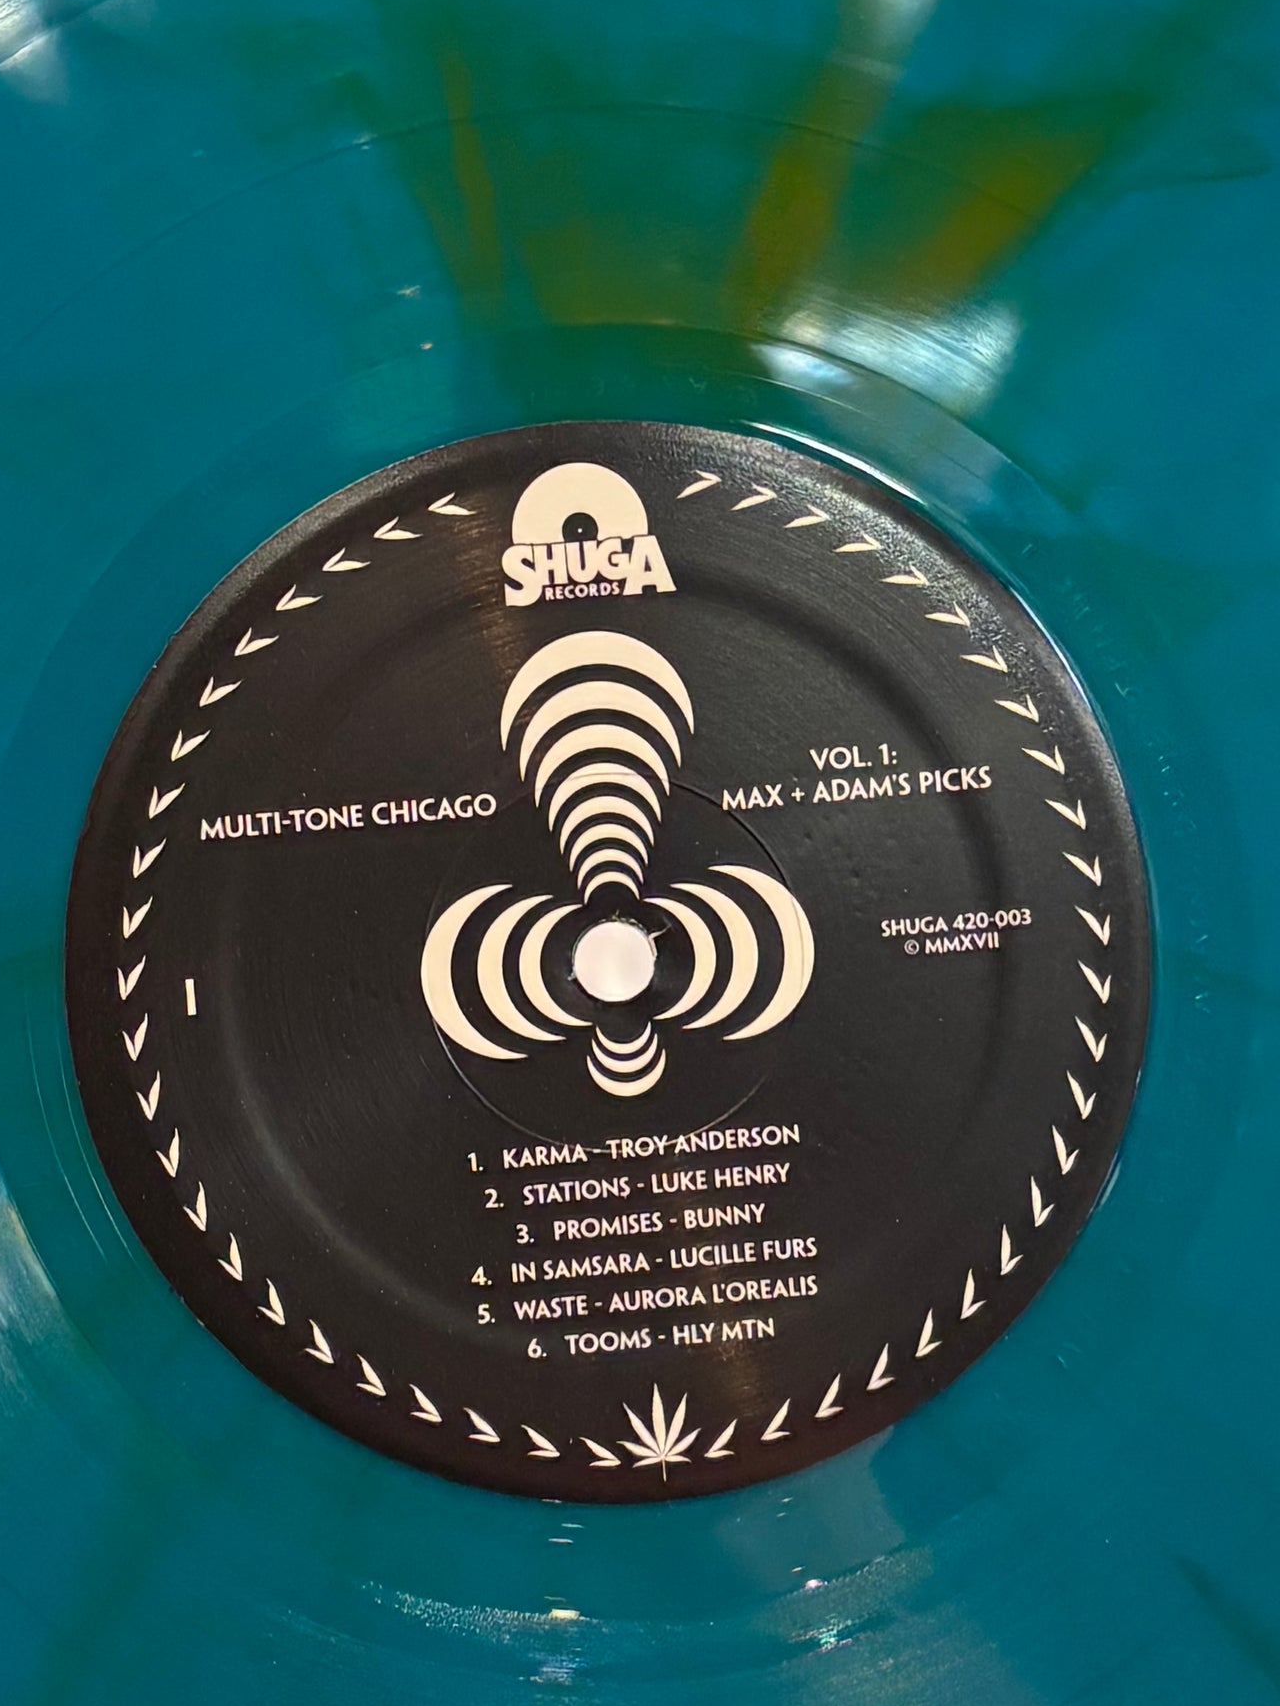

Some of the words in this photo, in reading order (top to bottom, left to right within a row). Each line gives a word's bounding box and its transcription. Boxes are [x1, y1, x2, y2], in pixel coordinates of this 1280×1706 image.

[502, 532, 676, 606] SHUGA
[542, 580, 619, 600] RECORDS
[810, 746, 872, 770] VOL.
[879, 743, 897, 765] 1:
[723, 784, 783, 810] MAX
[791, 787, 805, 801] +
[813, 773, 911, 803] ADAM'S
[919, 766, 992, 793] PICKS
[201, 805, 364, 840] MULTI-TONE
[372, 794, 496, 824] CHICAGO
[881, 916, 948, 936] SHUGA
[953, 909, 1031, 930] 420-003
[925, 932, 999, 953] MMXVII
[468, 1153, 483, 1171] 1.
[503, 1144, 587, 1168] KARMA
[606, 1136, 669, 1159] TROY
[674, 1124, 800, 1153] ANDERSON
[485, 1189, 504, 1208] 2.
[523, 1177, 630, 1205] STATIONS
[652, 1170, 707, 1193] LUKE
[715, 1163, 789, 1188] HENRY
[517, 1224, 534, 1243] 3.
[554, 1212, 663, 1240] PROMISES
[684, 1203, 765, 1229] BUNNY
[472, 1266, 492, 1285] 4.
[512, 1262, 536, 1282] IN
[544, 1252, 650, 1279] SAMSARA
[671, 1243, 756, 1268] LUCILLE
[763, 1237, 817, 1260] FURS
[478, 1304, 495, 1324] 5.
[514, 1295, 588, 1320] WASTE
[609, 1286, 706, 1312] AURORA
[713, 1276, 817, 1303] L'OREALIS
[528, 1338, 546, 1358] 6.
[564, 1328, 651, 1354] TOOMS
[673, 1323, 714, 1345] HLY
[722, 1318, 774, 1341] MTN
